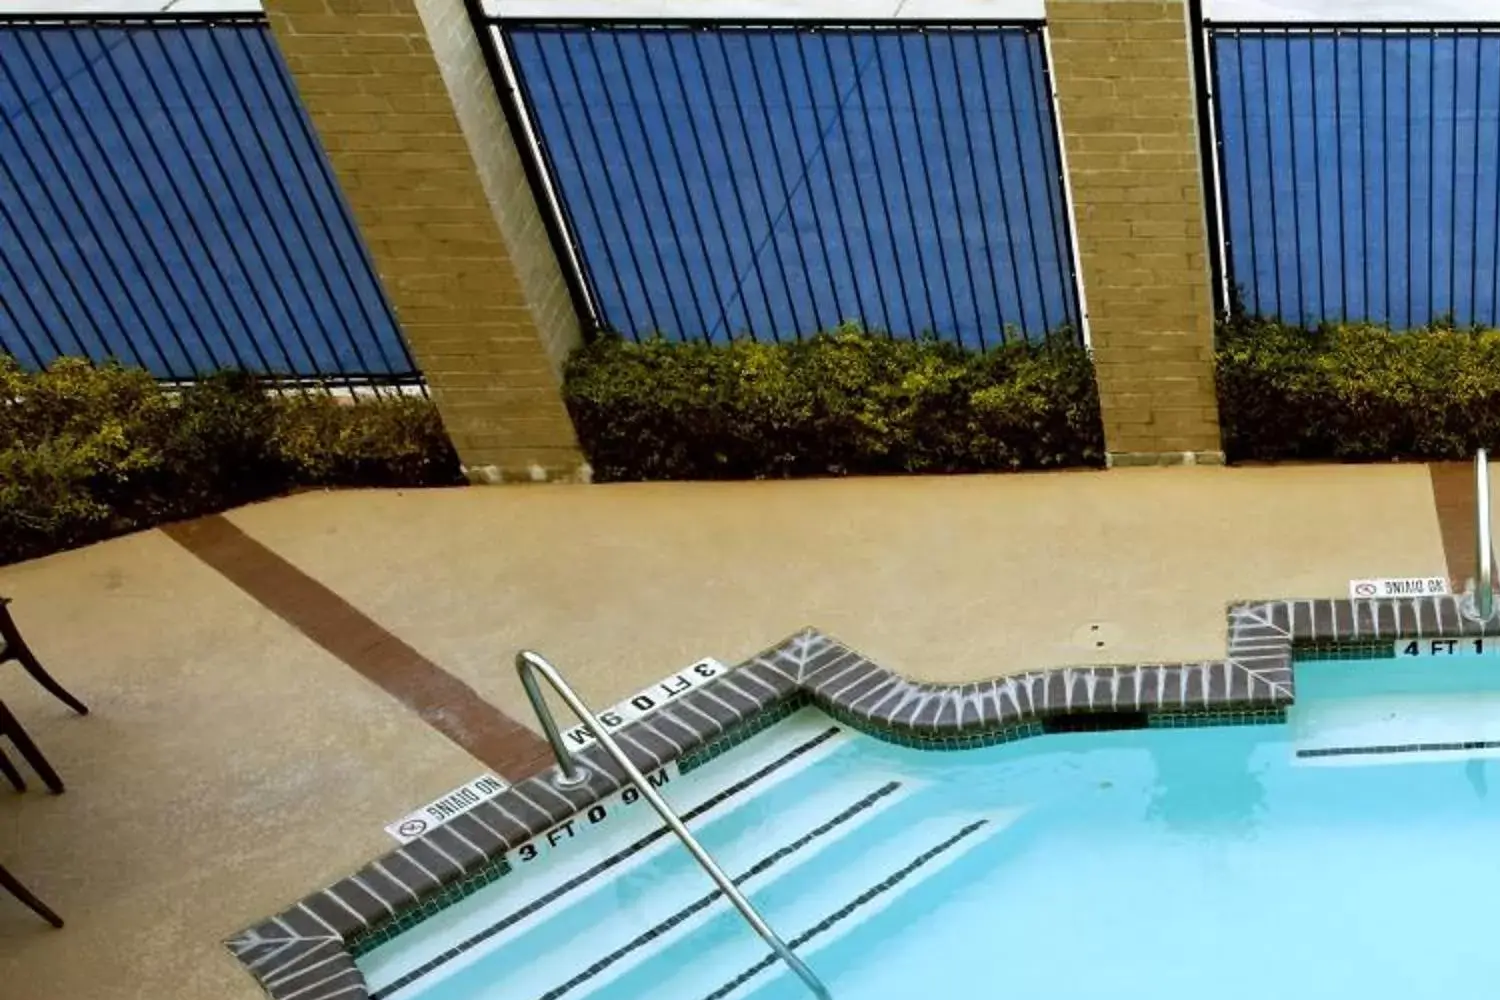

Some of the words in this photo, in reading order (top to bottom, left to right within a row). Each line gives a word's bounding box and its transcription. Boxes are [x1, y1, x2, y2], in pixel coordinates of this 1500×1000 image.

[1404, 640, 1419, 656] 4
[1431, 639, 1458, 655] FT
[694, 662, 717, 678] 3
[661, 677, 692, 699] FT
[477, 775, 502, 796] NO
[428, 788, 477, 820] DIVING
[519, 844, 539, 863] 3
[546, 820, 576, 849] FT
